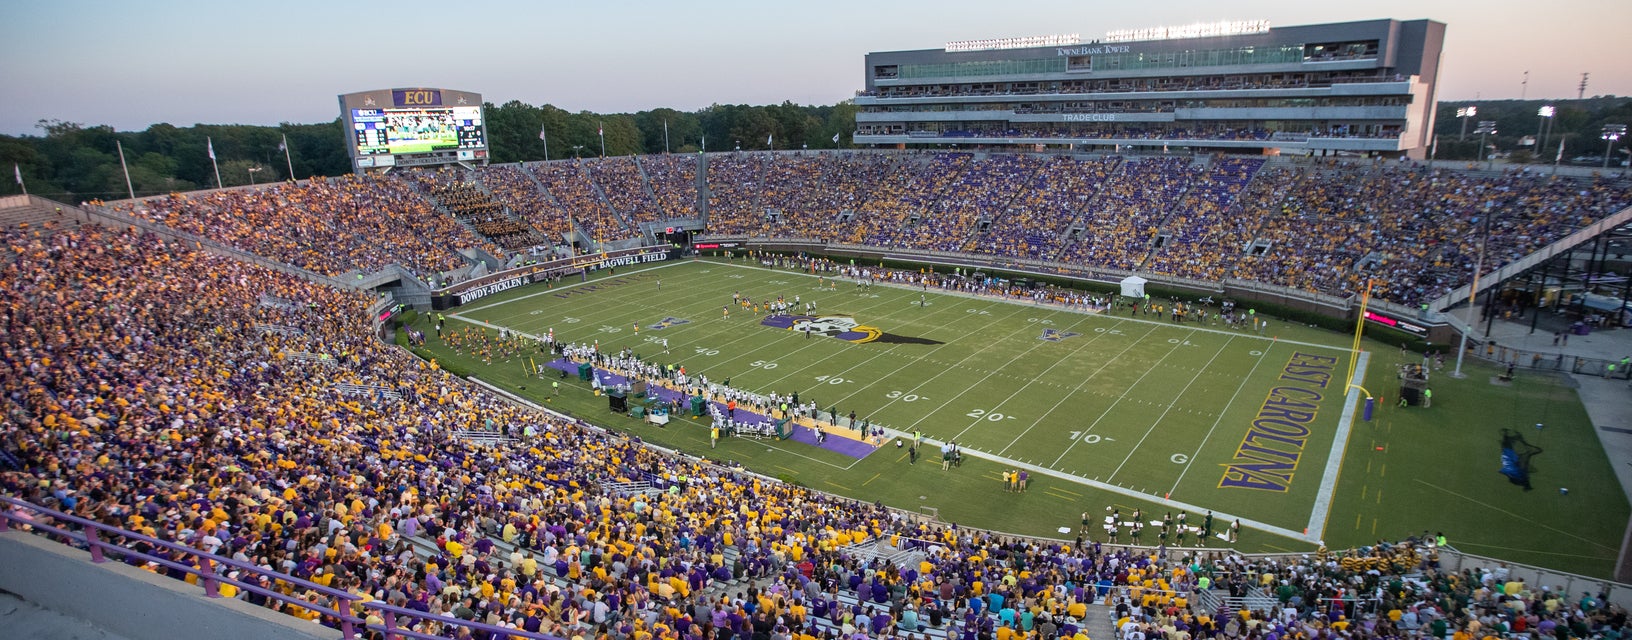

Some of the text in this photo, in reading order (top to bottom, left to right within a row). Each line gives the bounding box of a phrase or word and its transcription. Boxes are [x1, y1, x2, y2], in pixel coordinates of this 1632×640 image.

[404, 91, 433, 104] ECU
[1062, 113, 1116, 121] TRADE CLUB
[461, 252, 667, 304] DOWDY-FICKLEN BAGWELL FIELD
[750, 360, 778, 370] 50
[814, 375, 844, 385] 40
[886, 391, 919, 402] 30
[966, 409, 1004, 422] 20
[1217, 350, 1340, 493] EAST CAROLINA
[1069, 431, 1101, 444] 10
[1170, 453, 1189, 464] G
